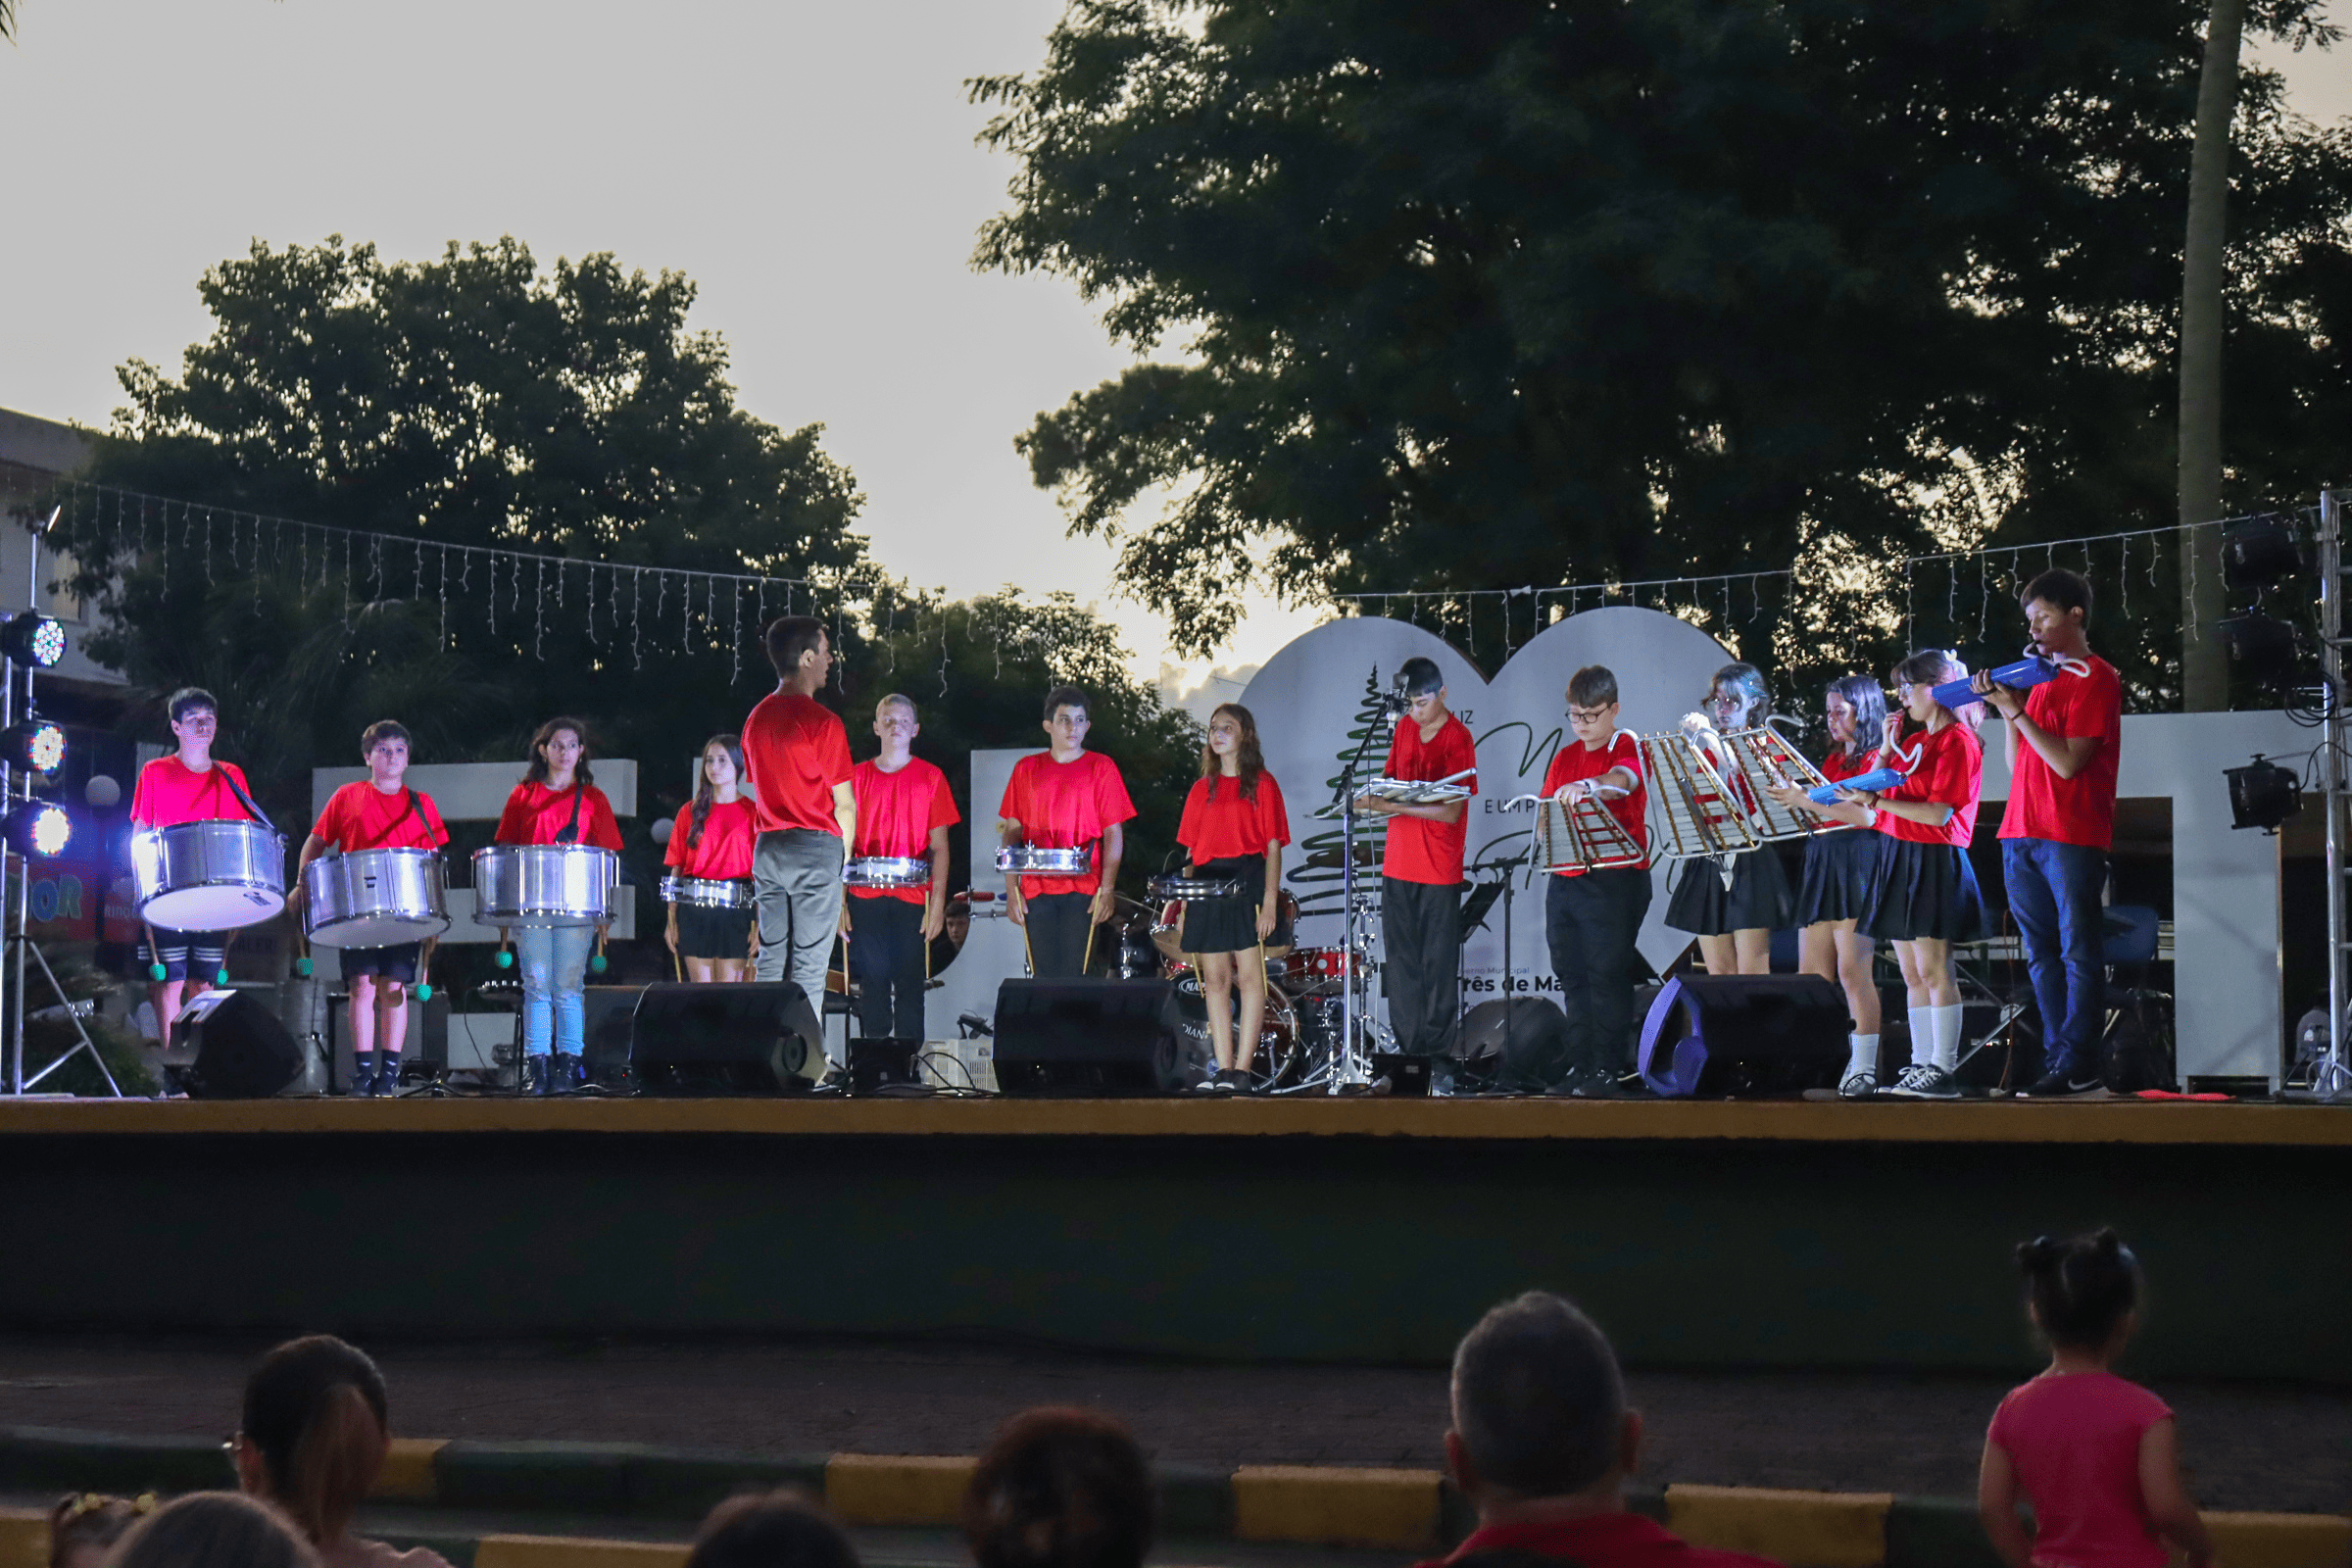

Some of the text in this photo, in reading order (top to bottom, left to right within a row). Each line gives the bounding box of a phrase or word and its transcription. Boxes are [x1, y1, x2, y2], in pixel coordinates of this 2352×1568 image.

[1488, 967, 1530, 976] Muncipal
[1501, 976, 1529, 992] de
[1535, 976, 1562, 992] Ma
